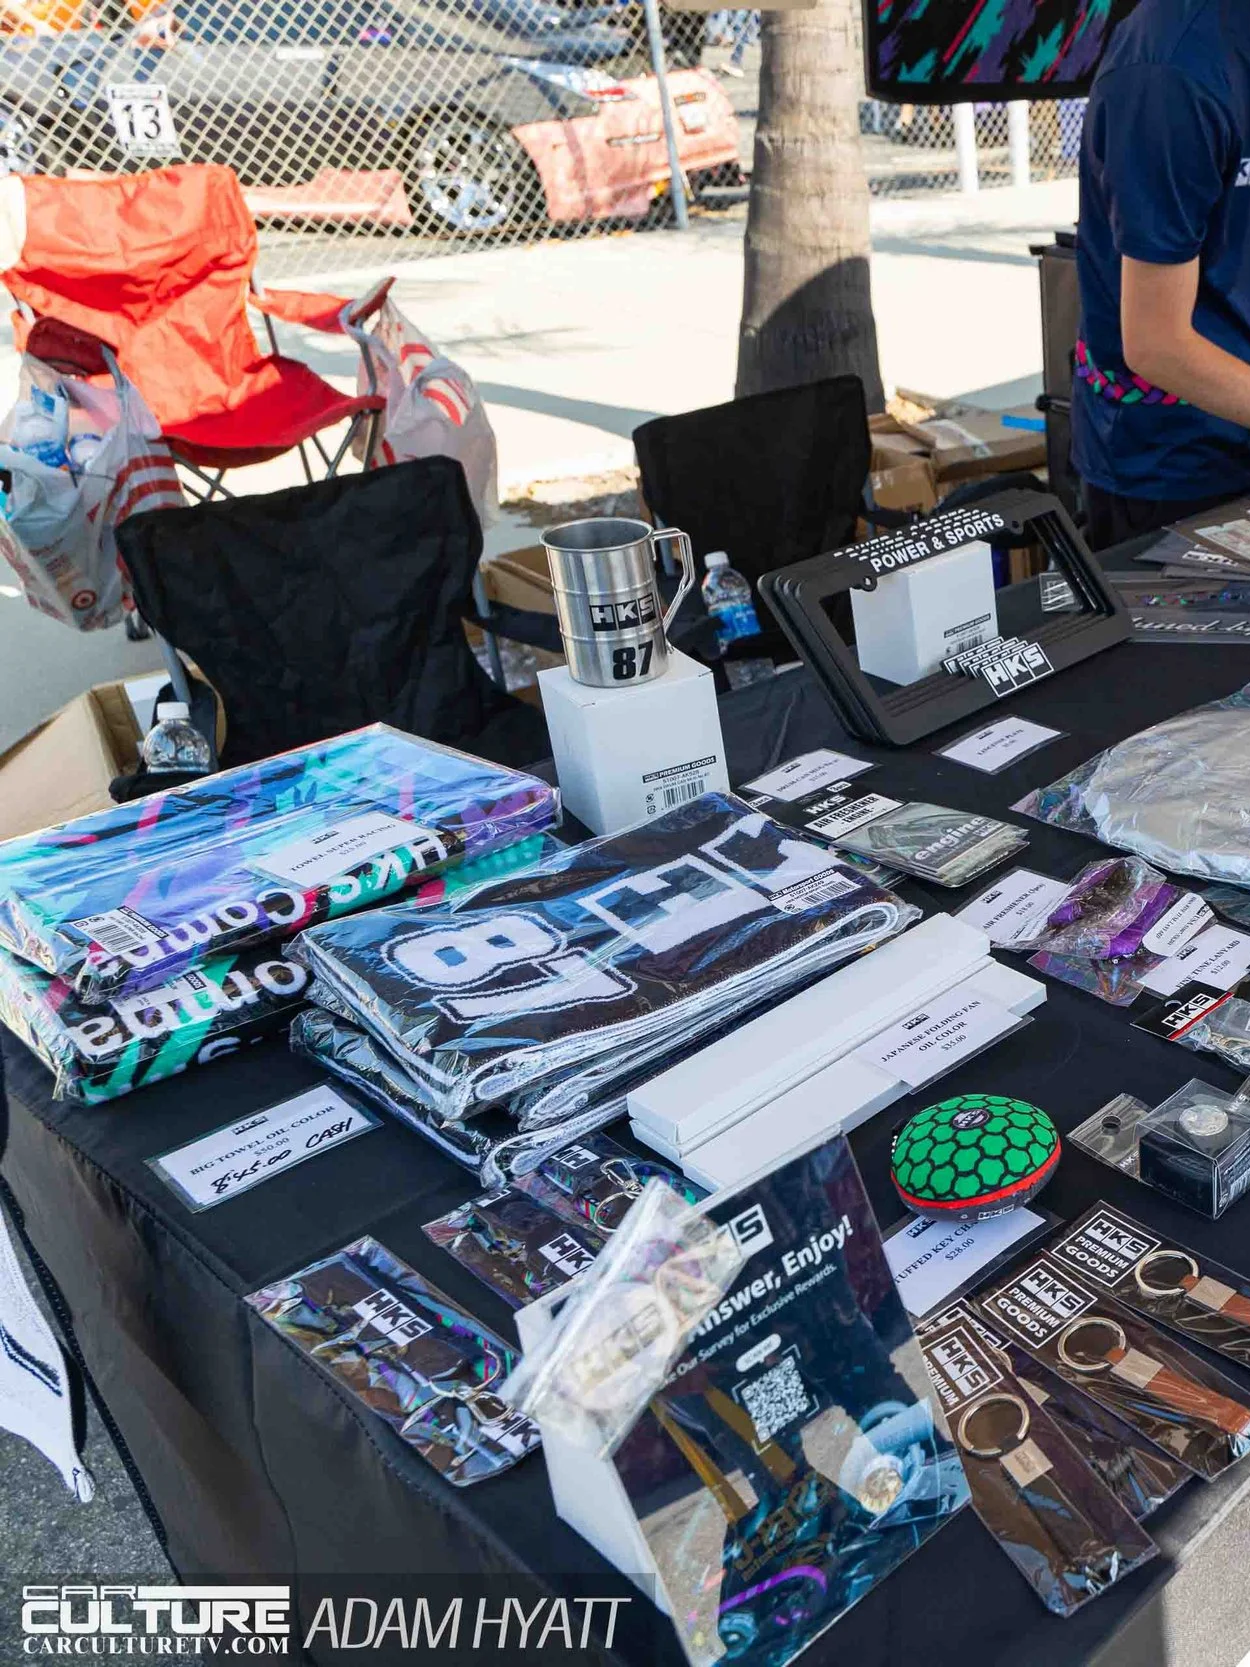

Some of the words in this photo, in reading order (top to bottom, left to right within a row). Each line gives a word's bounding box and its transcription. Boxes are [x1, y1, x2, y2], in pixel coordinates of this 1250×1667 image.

[122, 104, 161, 139] 13
[870, 540, 930, 572] POWER
[931, 534, 945, 550] &
[944, 513, 1004, 545] SPORTS
[591, 594, 655, 628] HKS
[612, 641, 653, 681] 87
[984, 645, 1045, 687] HKS
[659, 764, 690, 777] PREMIUM
[691, 757, 714, 768] GOODS
[804, 794, 847, 814] HKS
[813, 817, 832, 827] AIR
[830, 796, 878, 820] FRESHENER
[290, 853, 325, 871] TOWEL
[325, 837, 357, 853] SUPER
[357, 822, 396, 839] RACING
[915, 816, 986, 862] engine
[813, 868, 834, 880] GOODS
[982, 919, 996, 930] AIR
[992, 892, 1030, 921] FRESHENER
[1175, 944, 1197, 960] HKS
[1192, 959, 1212, 975] TUNE
[1209, 938, 1240, 961] LANYARD
[1210, 958, 1230, 974] $12.00
[902, 1011, 930, 1031] HKS
[1163, 992, 1212, 1026] HKS
[880, 1033, 924, 1062] JAPANESE
[924, 1008, 963, 1035] FOLDING
[961, 999, 981, 1012] FAN
[918, 1038, 936, 1052] OIL
[935, 1020, 967, 1041] COLOR
[941, 1033, 966, 1051] $35.00
[190, 1160, 214, 1175] BIG
[217, 1137, 262, 1162] TOWEL
[265, 1125, 289, 1140] OIL
[290, 1105, 335, 1128] COLOR
[253, 1136, 289, 1157] $50.00
[305, 1116, 351, 1149] CASH
[976, 1203, 1014, 1220] HKS
[778, 1213, 856, 1280] Enjoy!
[944, 1237, 975, 1261] $28.00
[1074, 1235, 1128, 1269] PREMIUM
[1090, 1219, 1147, 1256] HKS
[893, 1250, 932, 1284] TUFFED
[932, 1234, 955, 1253] KEY
[1064, 1244, 1118, 1278] GOODS
[1008, 1285, 1059, 1328] PREMIUM
[1028, 1268, 1082, 1312] HKS
[363, 1292, 429, 1338] HKS
[676, 1354, 699, 1375] Our
[696, 1330, 736, 1360] Survey
[732, 1319, 750, 1336] for
[748, 1289, 795, 1325] Exclusive
[792, 1260, 837, 1295] Rewards.
[996, 1296, 1047, 1338] GOODS
[939, 1338, 986, 1389] HKS
